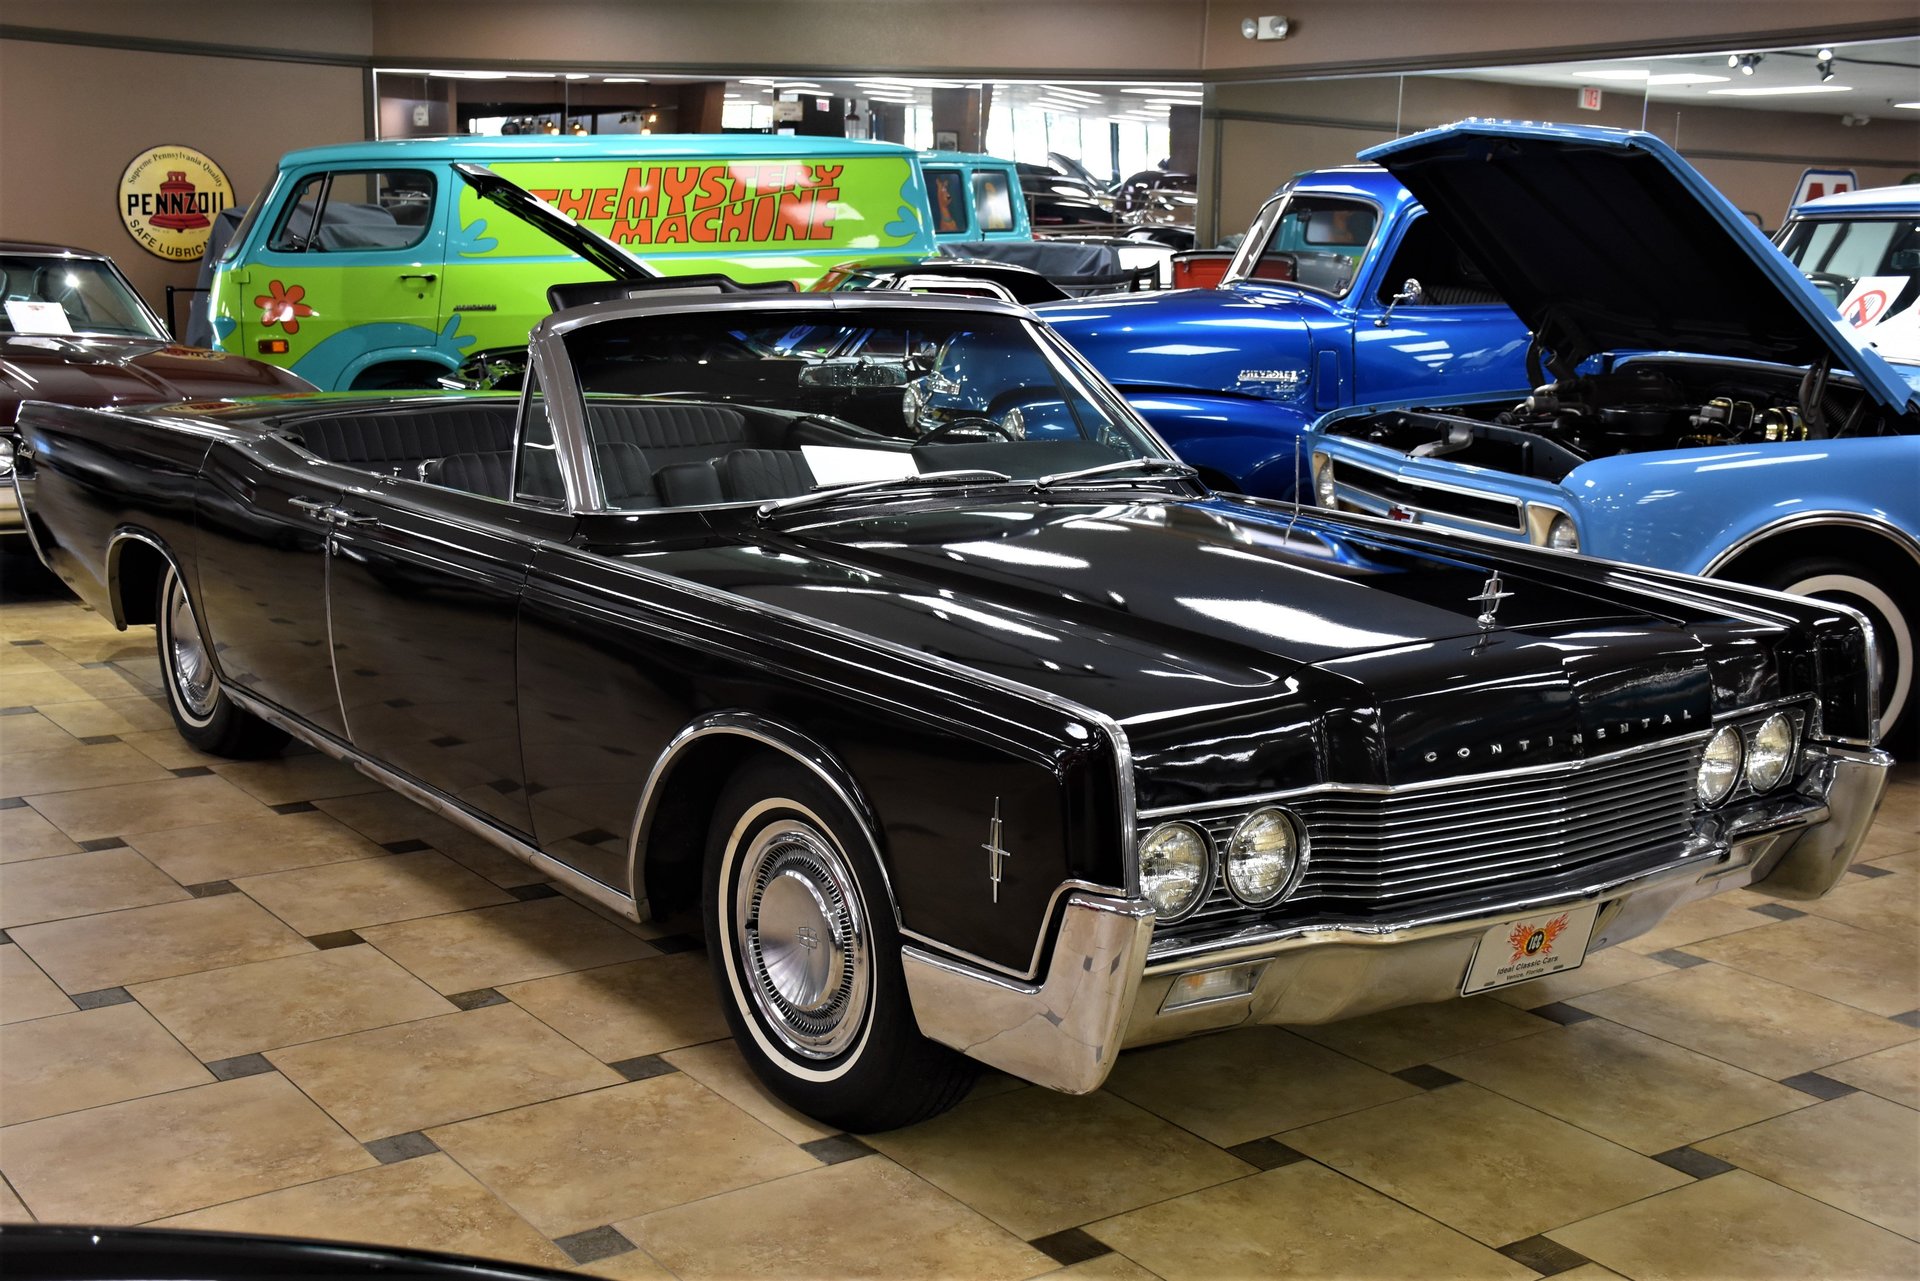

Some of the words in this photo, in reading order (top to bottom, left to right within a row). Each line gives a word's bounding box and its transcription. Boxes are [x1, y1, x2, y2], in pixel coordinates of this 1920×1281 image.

[128, 158, 153, 185] Supreme
[152, 152, 202, 166] Pennsylvania
[202, 162, 223, 187] Quality
[528, 188, 619, 220] THE
[614, 165, 844, 220] MYSTERY
[608, 187, 840, 245] MACHINE
[130, 219, 157, 248] SAFE
[1424, 709, 1691, 762] CONTINENTAL
[1497, 965, 1514, 975] Ideal
[1515, 959, 1541, 971] Classic
[1542, 956, 1558, 965] Cars
[1506, 972, 1524, 980] Venice,
[1525, 967, 1544, 976] Florida
